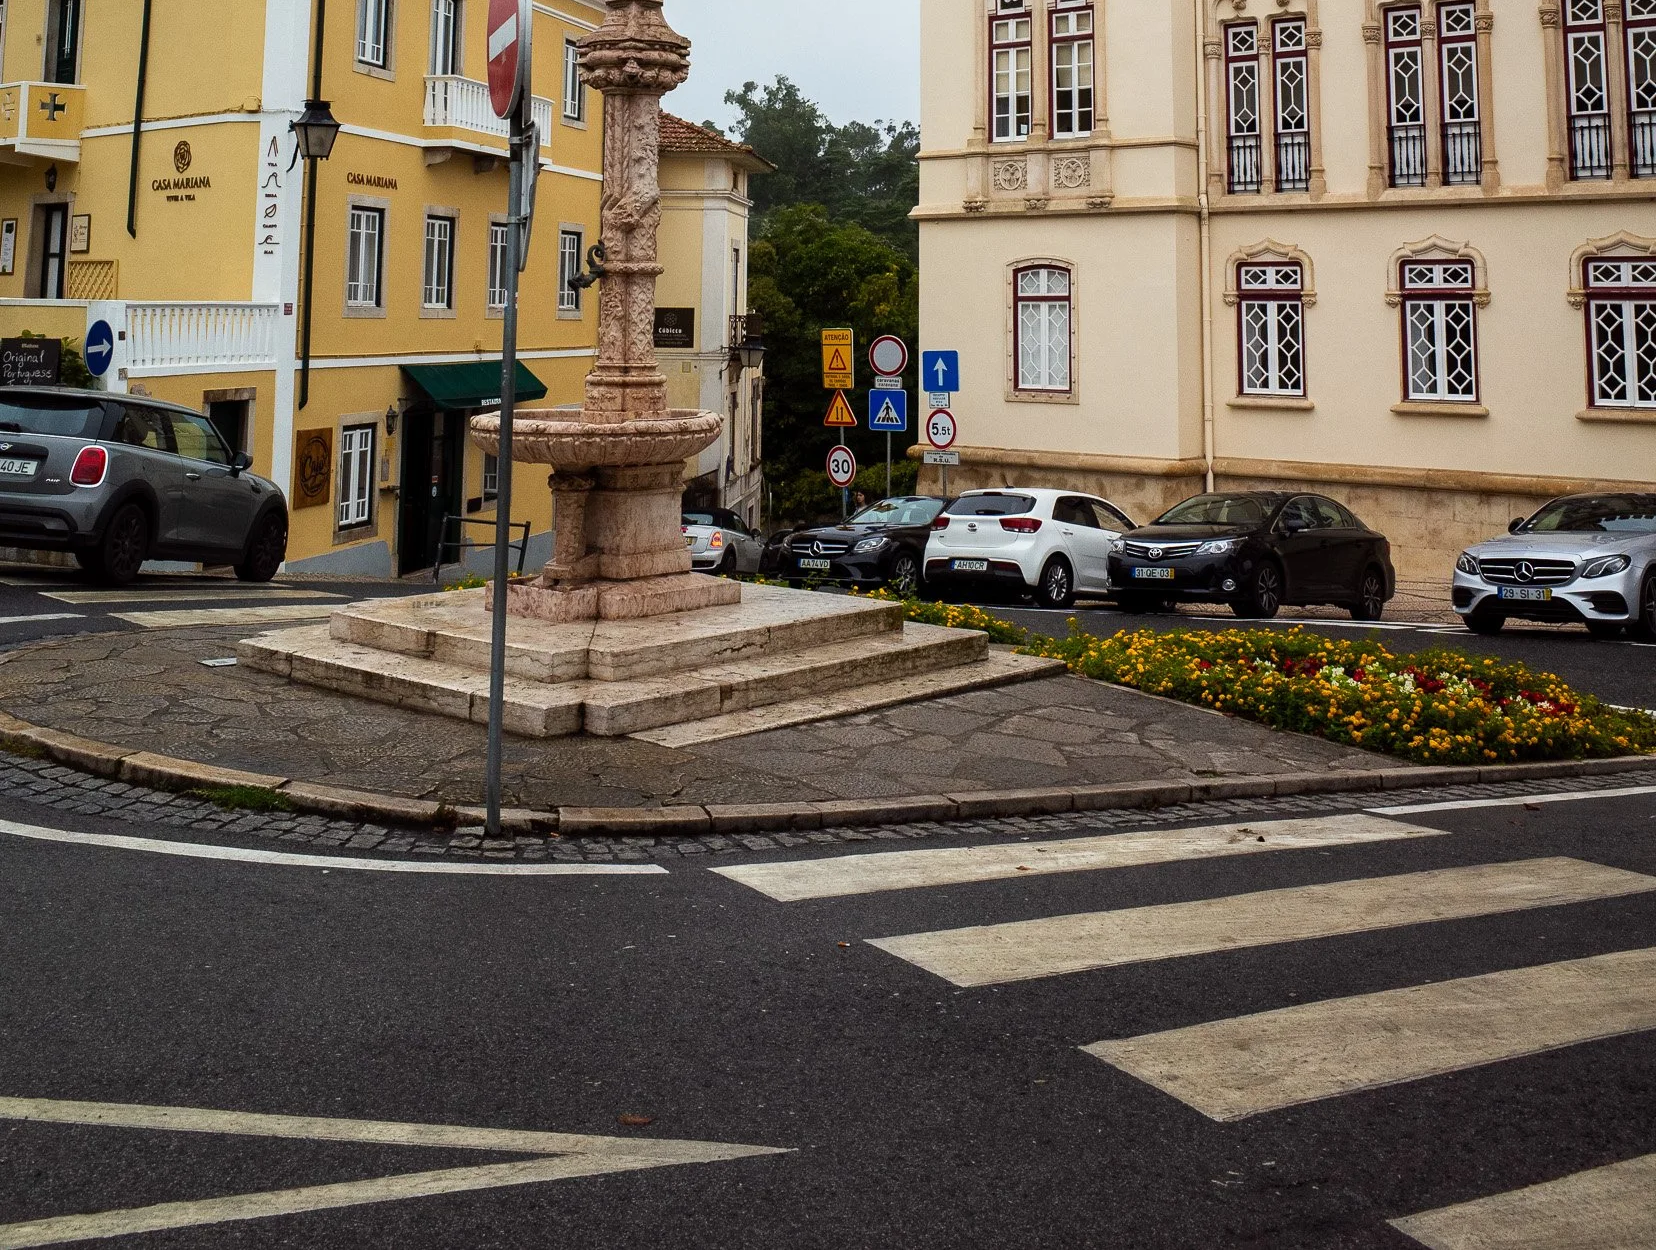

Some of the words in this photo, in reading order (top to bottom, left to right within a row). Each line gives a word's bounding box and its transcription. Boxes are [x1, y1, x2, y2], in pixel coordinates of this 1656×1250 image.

[152, 179, 172, 191] CASA
[173, 176, 211, 190] MARIANA
[347, 172, 365, 185] CASA
[366, 174, 398, 190] MARIANA
[824, 332, 849, 342] ATENÇÃO
[3, 350, 45, 367] Original
[3, 363, 52, 383] Portuguese
[832, 459, 850, 474] 30
